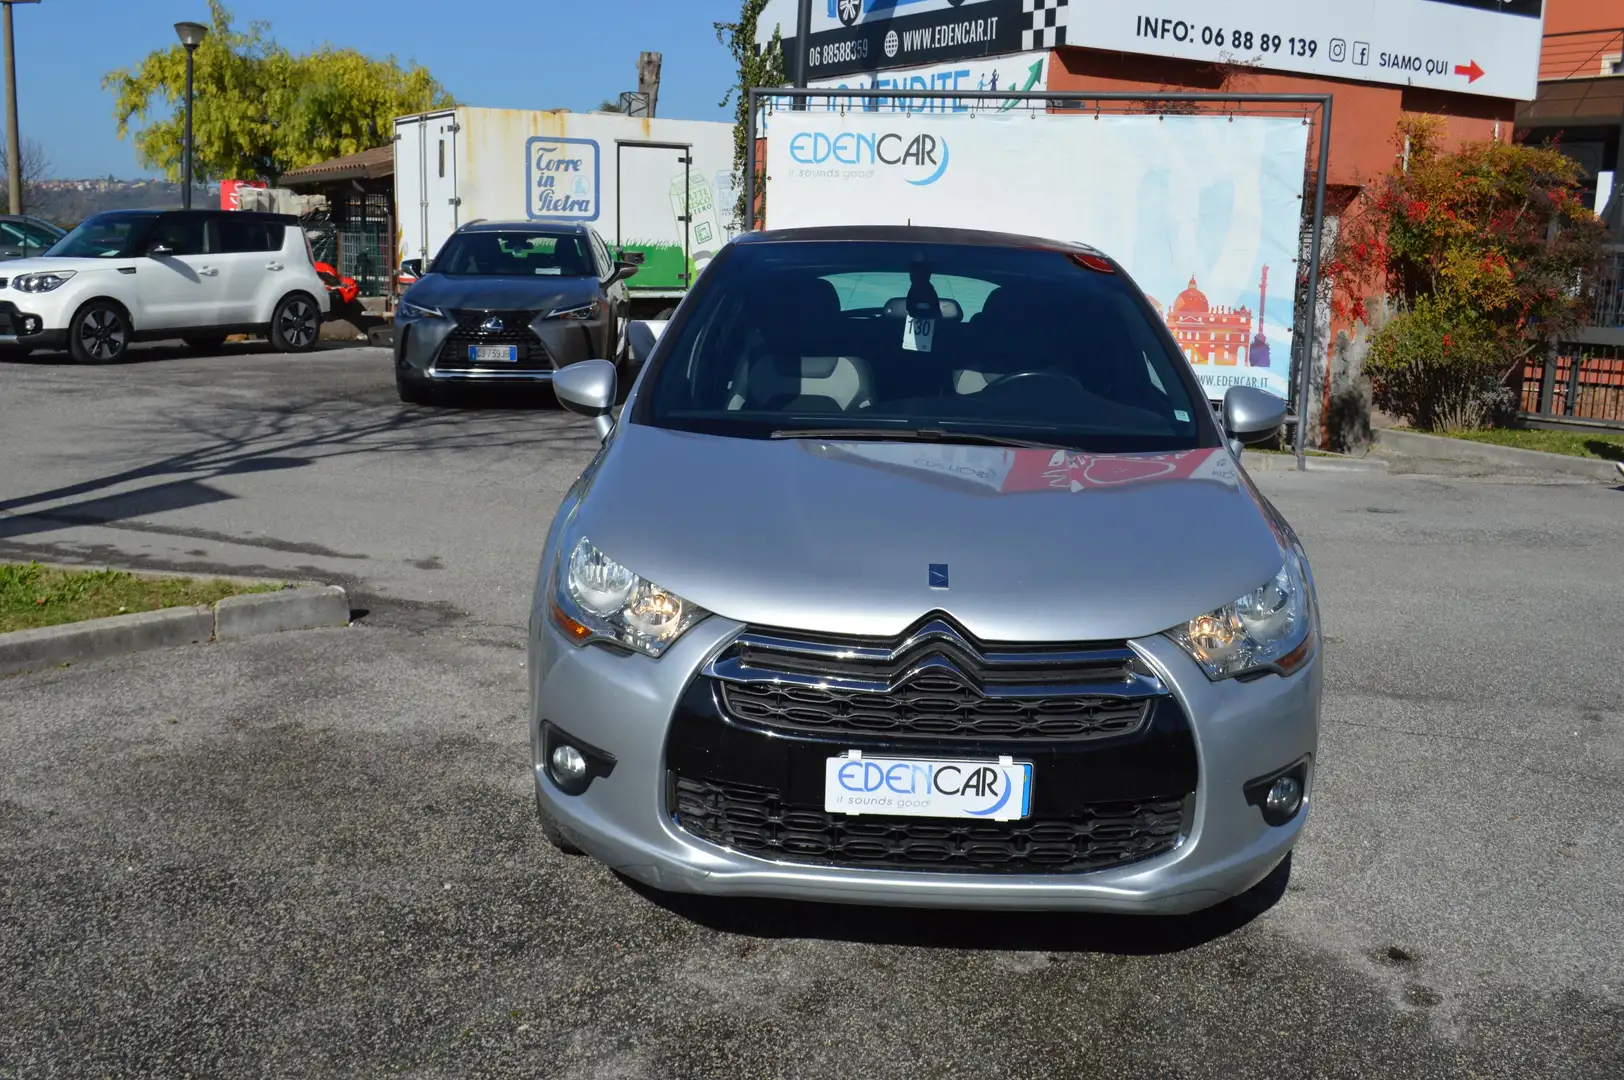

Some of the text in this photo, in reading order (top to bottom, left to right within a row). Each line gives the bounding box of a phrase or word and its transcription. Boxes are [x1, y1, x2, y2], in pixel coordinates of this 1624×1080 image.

[903, 17, 998, 51] WWW.EDENCAR.IT
[1136, 15, 1318, 58] INFO: 06 88 89 139
[809, 38, 868, 67] 06 88588359
[1379, 52, 1449, 75] SIAMO QUI
[860, 69, 970, 113] VENDITE
[536, 147, 582, 172] Torre
[789, 132, 937, 166] EDENCAR
[537, 172, 555, 188] in
[538, 188, 590, 212] Pietra
[838, 761, 998, 797] EDENCAR
[848, 796, 893, 806] sounds
